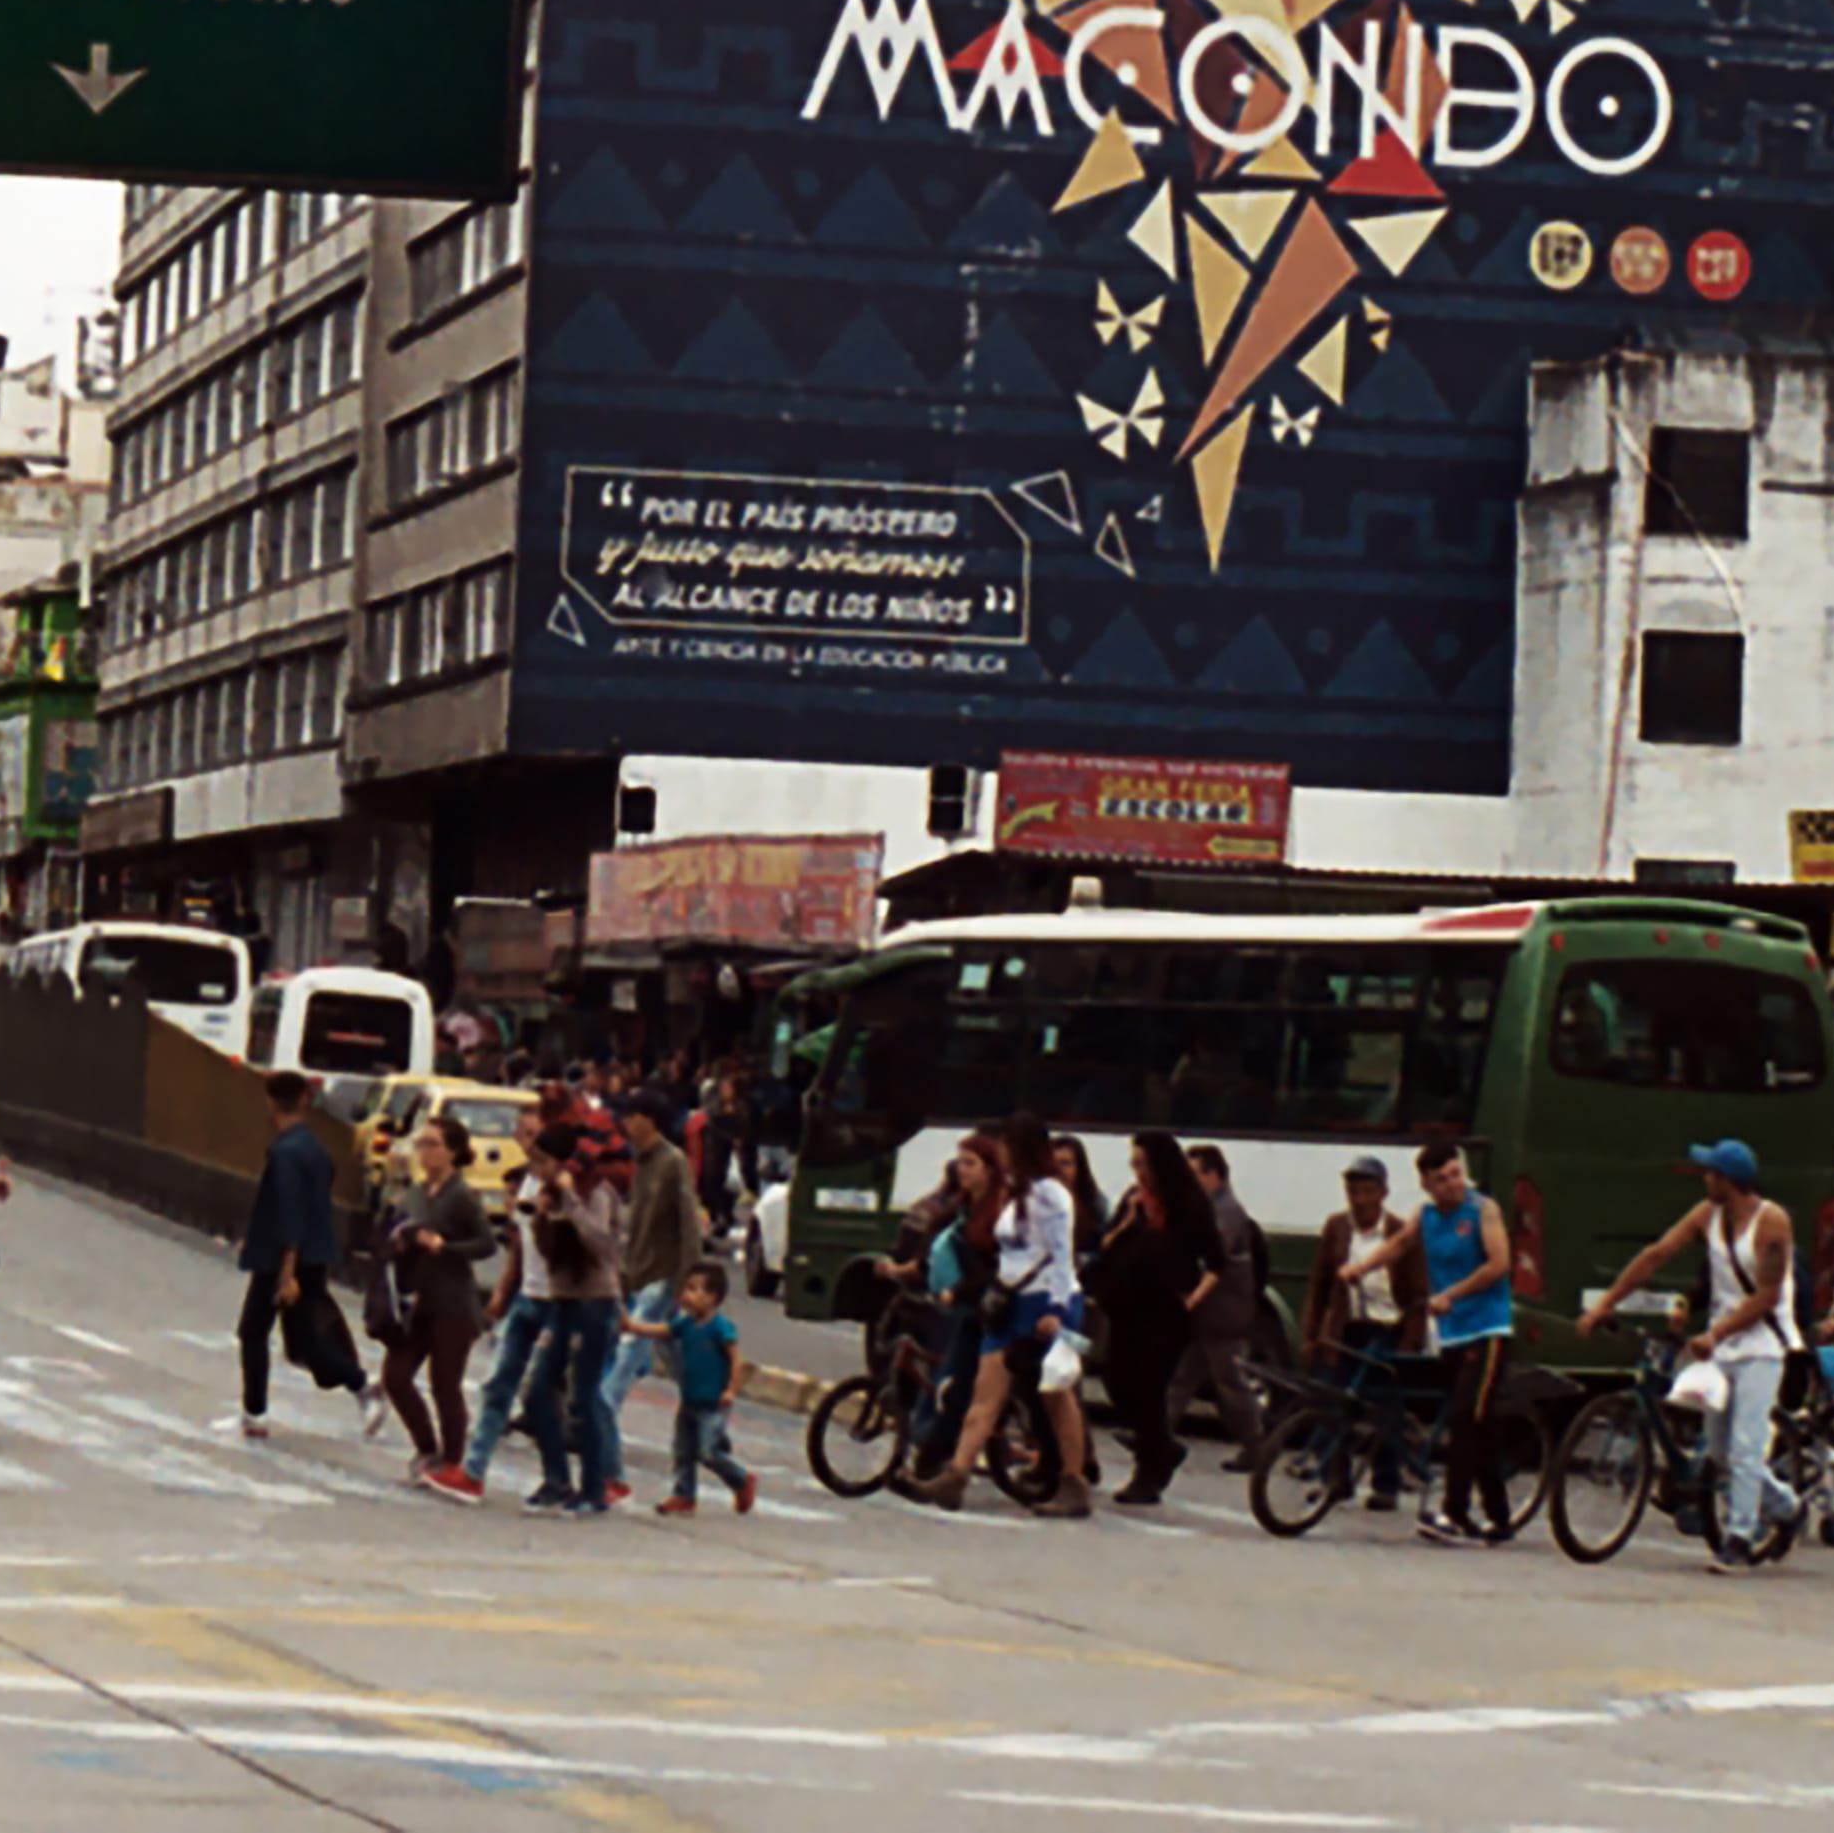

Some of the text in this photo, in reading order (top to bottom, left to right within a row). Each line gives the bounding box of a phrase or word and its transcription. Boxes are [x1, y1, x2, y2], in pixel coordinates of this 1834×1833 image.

[704, 499, 731, 528] EL
[596, 537, 628, 575] y
[612, 583, 644, 608] AL
[653, 584, 779, 614] ALCANCE
[784, 589, 820, 616] DE
[826, 592, 880, 619] LOS
